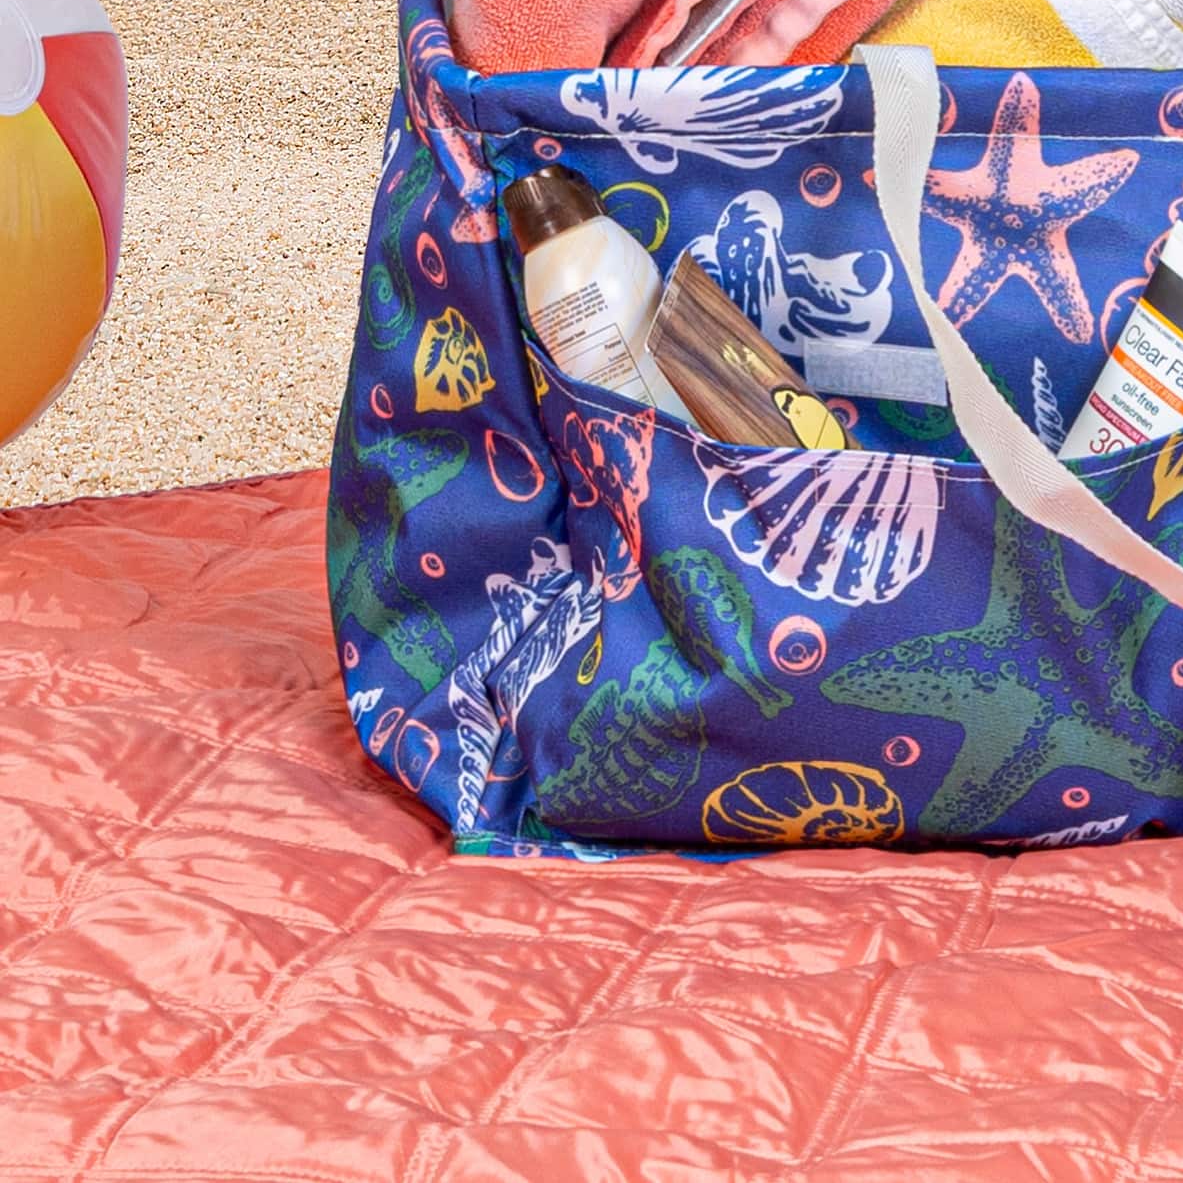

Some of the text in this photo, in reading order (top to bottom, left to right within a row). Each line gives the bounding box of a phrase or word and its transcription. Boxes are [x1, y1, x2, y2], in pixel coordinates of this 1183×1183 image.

[1124, 324, 1168, 368] Clear
[1111, 394, 1153, 431] sunscreen
[1122, 383, 1159, 415] oil-free
